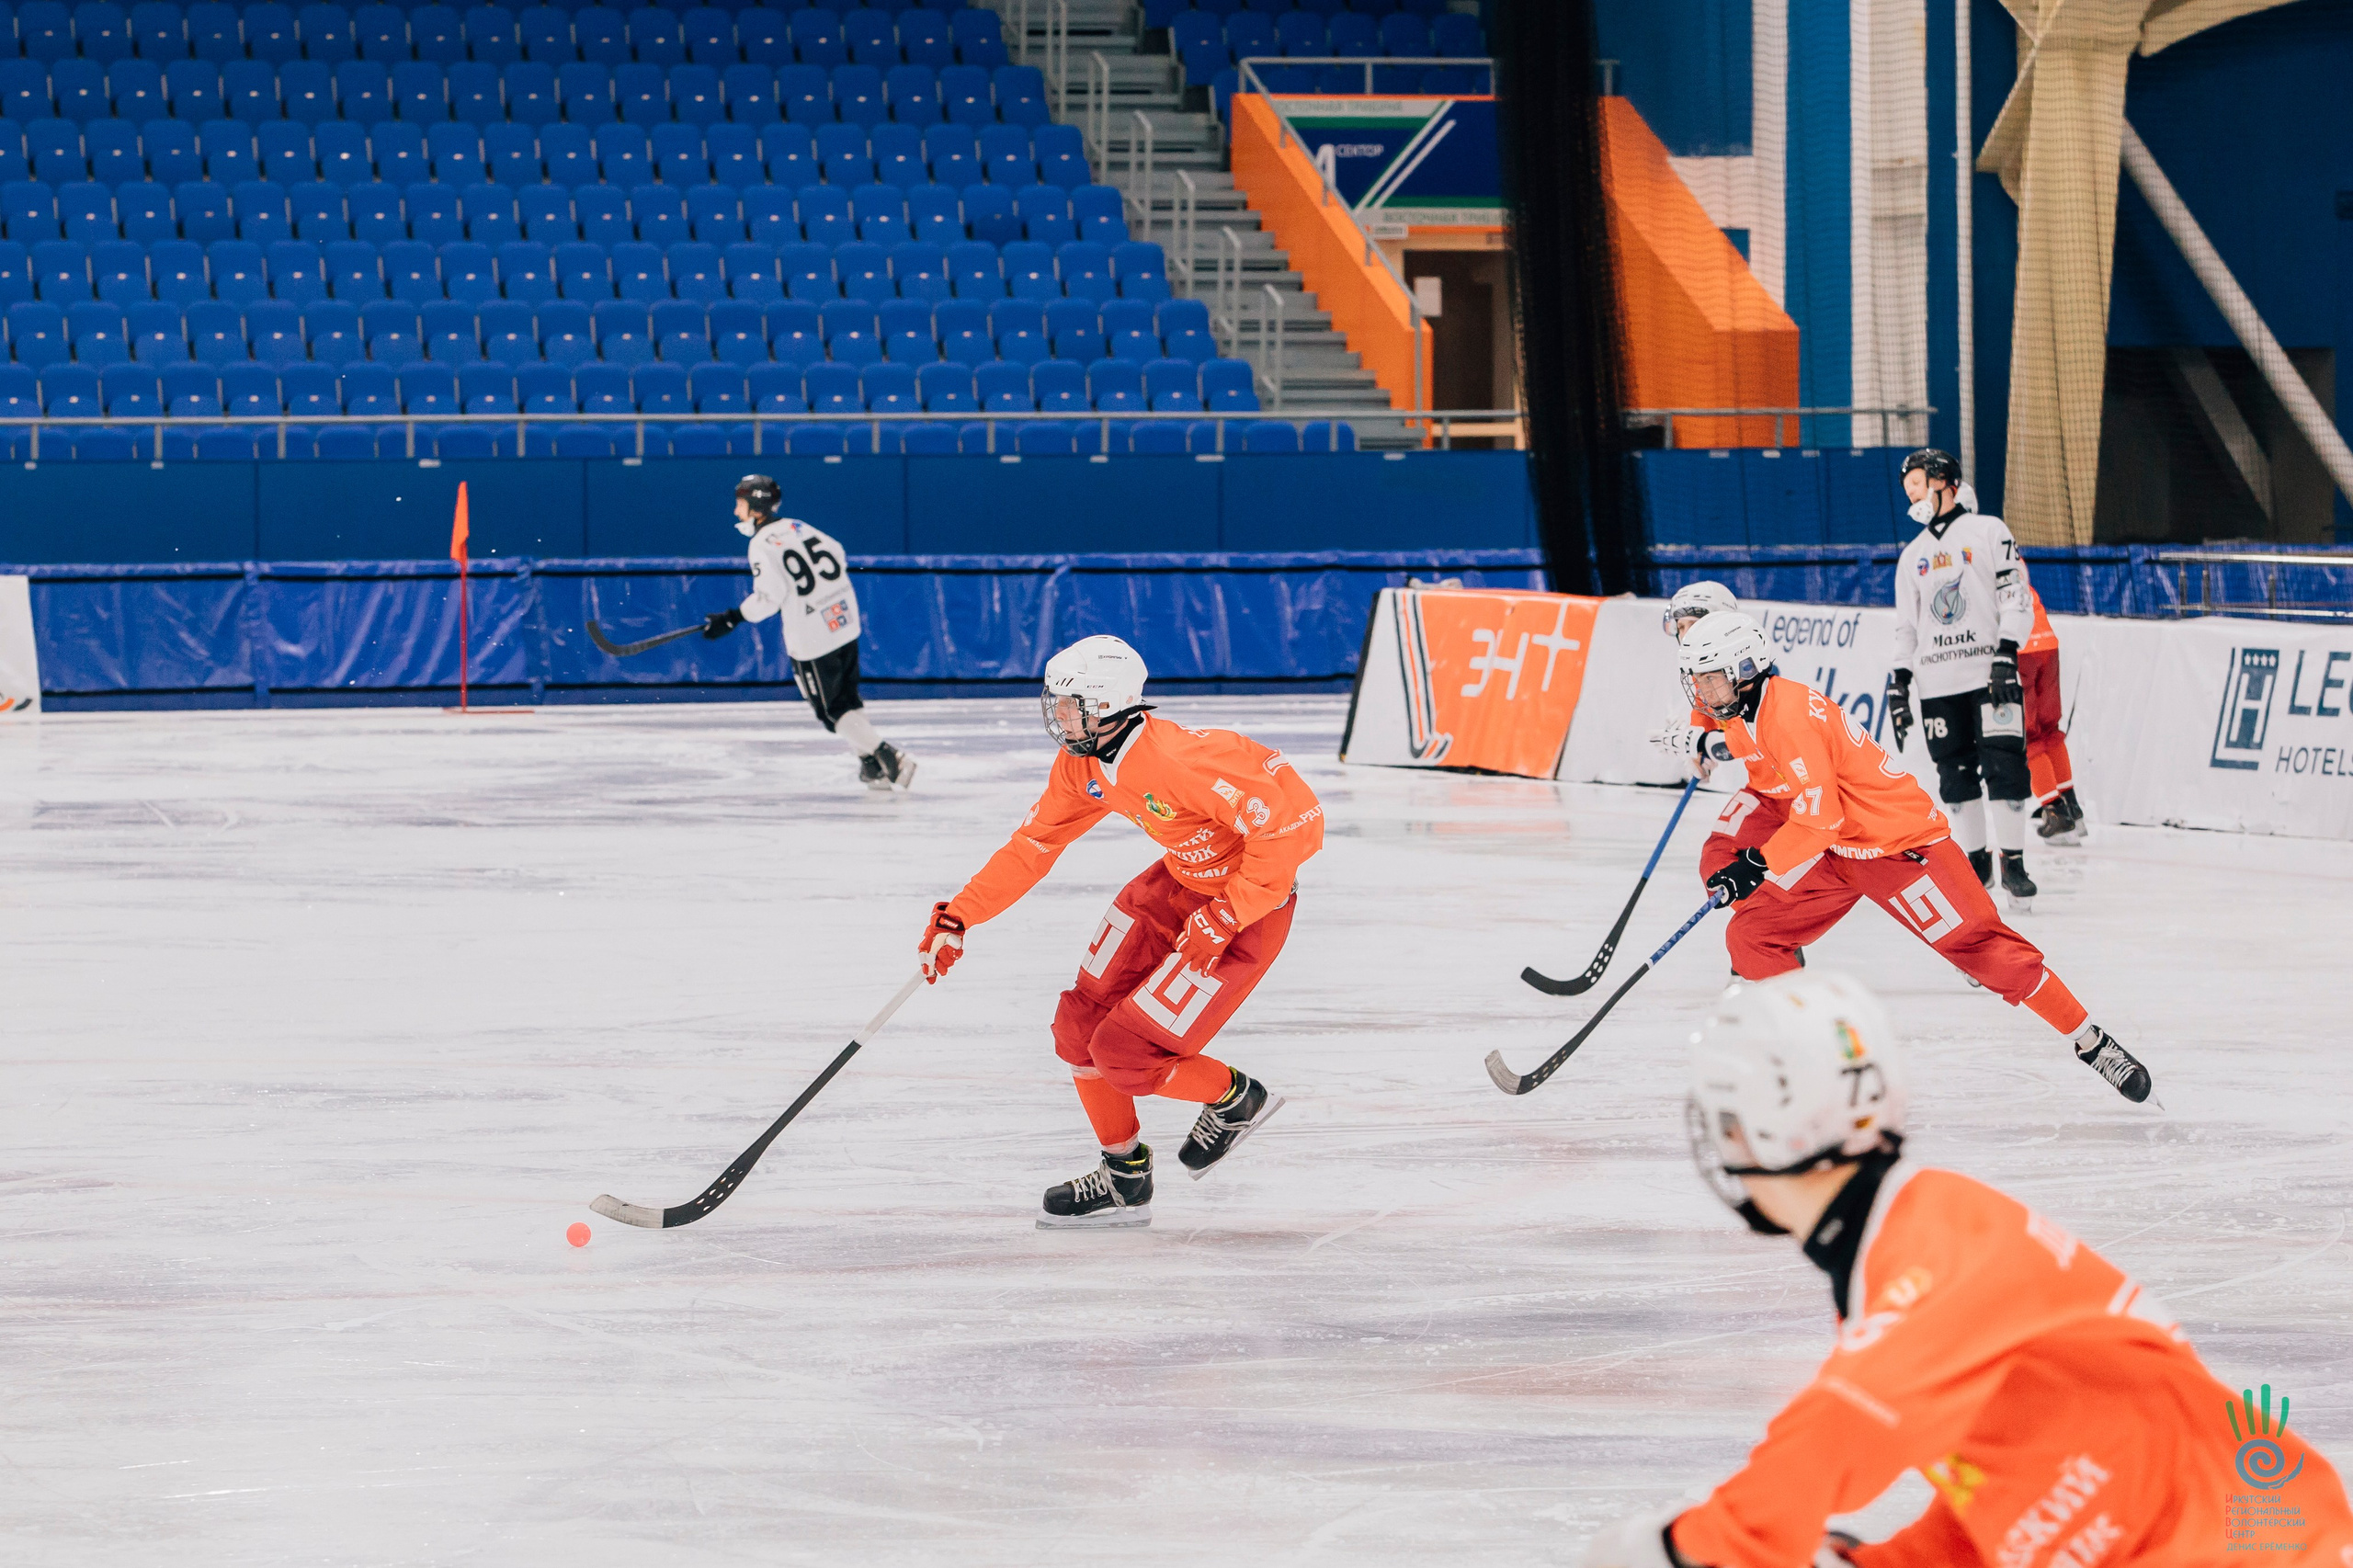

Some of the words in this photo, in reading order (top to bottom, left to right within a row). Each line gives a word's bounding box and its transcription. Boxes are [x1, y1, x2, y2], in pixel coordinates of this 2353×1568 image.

[783, 536, 841, 596] 95
[1837, 612, 1861, 648] of
[1932, 629, 1977, 648] Маяк
[2287, 648, 2353, 717] LE
[1924, 717, 1949, 740] 78
